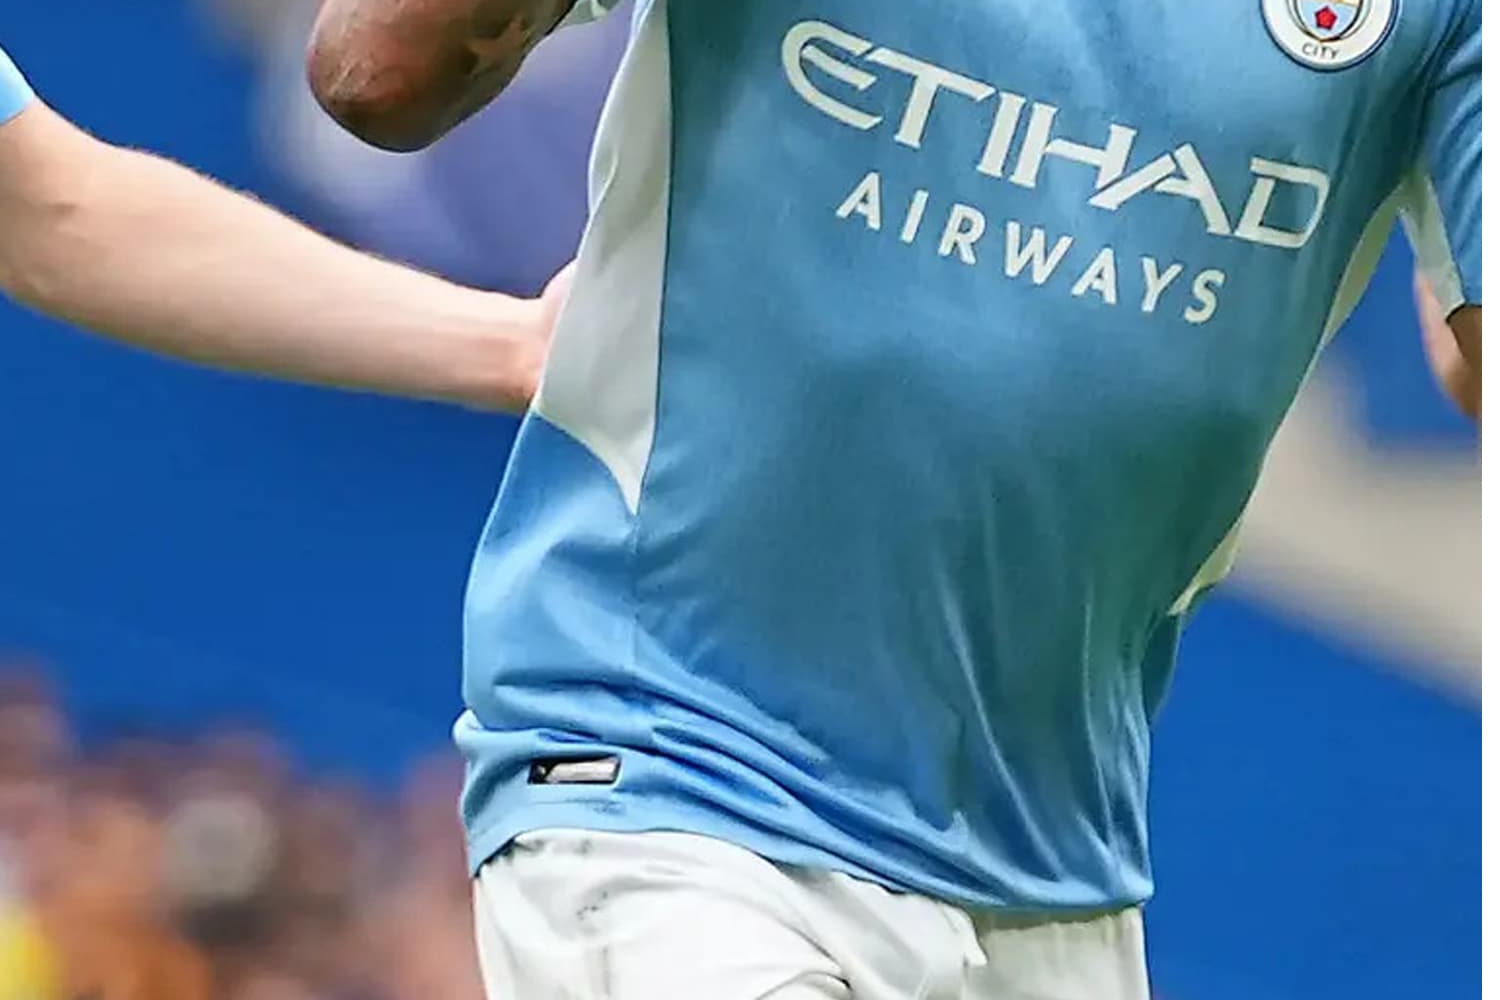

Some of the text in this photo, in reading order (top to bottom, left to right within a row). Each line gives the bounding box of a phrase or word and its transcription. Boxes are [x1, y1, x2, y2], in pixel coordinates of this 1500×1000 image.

[1302, 43, 1339, 59] CITY
[781, 20, 1331, 249] ETIHAD
[836, 172, 1225, 324] AIRWAYS
